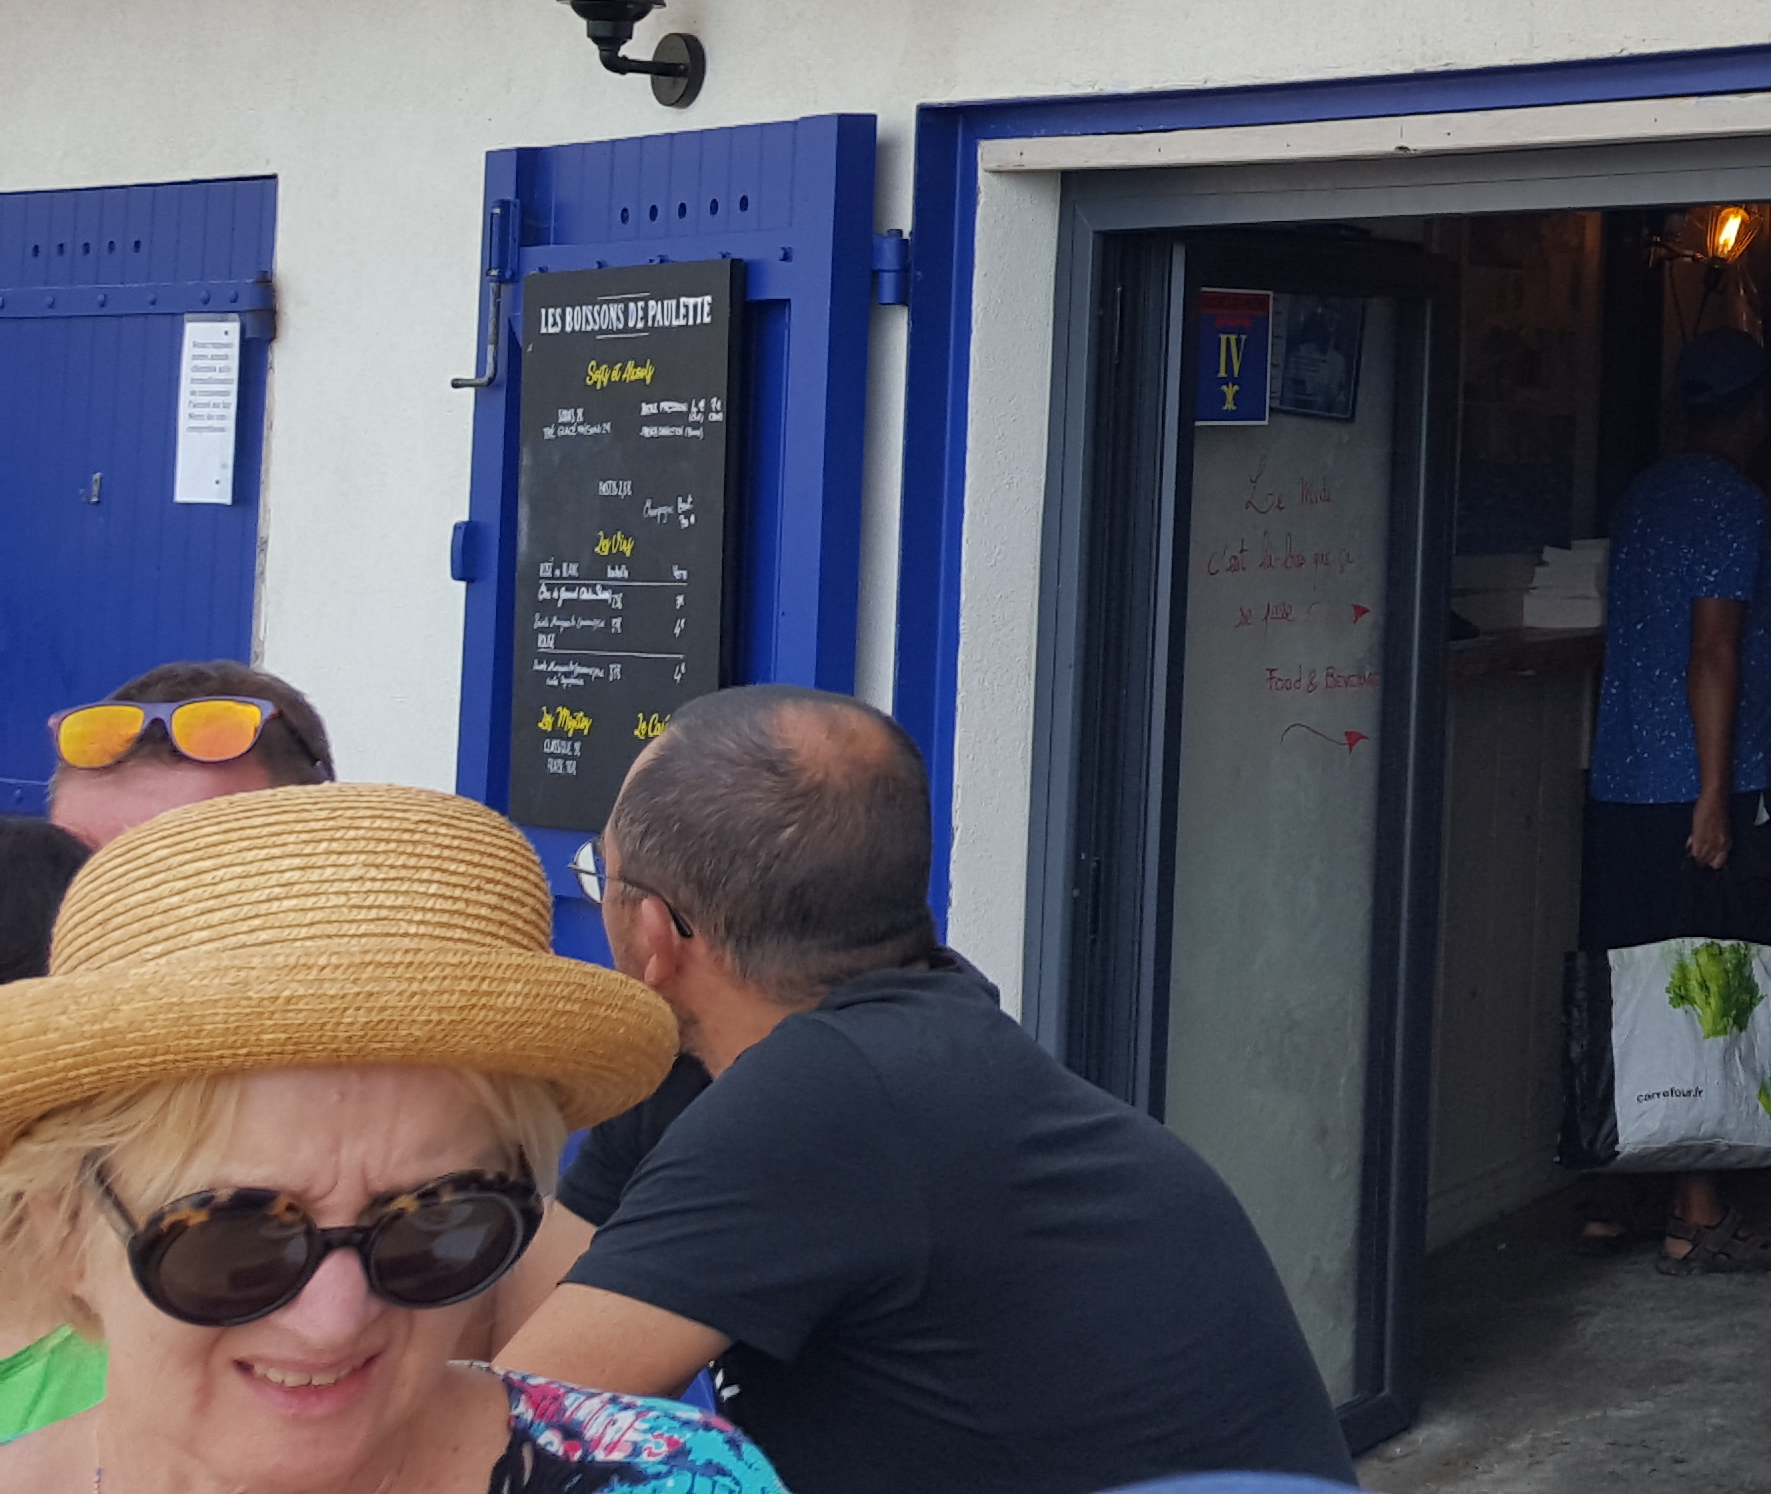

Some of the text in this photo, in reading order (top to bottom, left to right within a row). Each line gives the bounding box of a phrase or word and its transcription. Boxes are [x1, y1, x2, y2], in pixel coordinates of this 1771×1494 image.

[540, 295, 712, 333] LES BOISSONS DE PAULETTE
[1216, 332, 1247, 378] IV
[1266, 664, 1302, 691] Food
[1636, 1087, 1704, 1103] carrefour.fr
